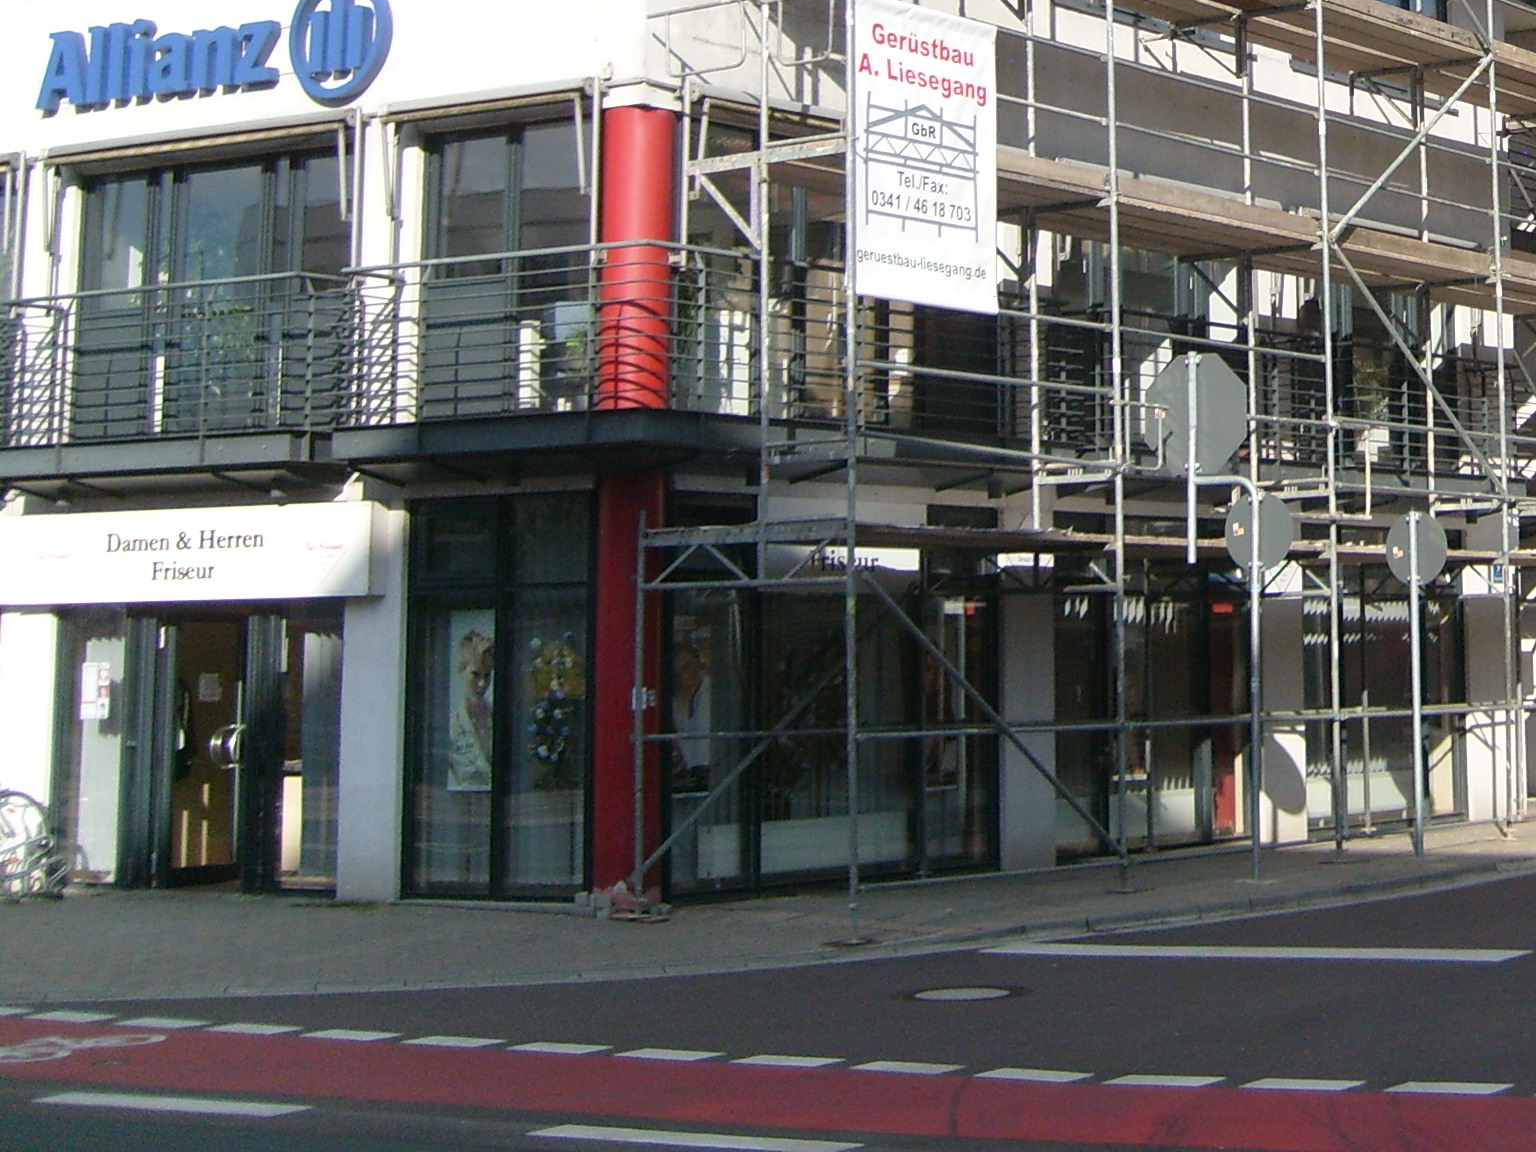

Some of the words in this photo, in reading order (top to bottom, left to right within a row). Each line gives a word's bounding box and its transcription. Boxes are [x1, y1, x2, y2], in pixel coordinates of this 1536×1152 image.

[871, 22, 975, 67] Gerüstbau
[35, 18, 282, 119] Allianz
[858, 52, 879, 77] A.
[886, 58, 988, 107] Liesegang
[911, 121, 937, 140] GbR
[871, 189, 901, 211] 0341
[913, 197, 929, 215] 46
[932, 201, 946, 218] 18
[949, 203, 972, 222] 703
[856, 249, 987, 281] geruestbau-liesegang.de
[106, 533, 170, 553] Damen
[175, 531, 193, 550] &
[198, 529, 264, 550] Herren
[151, 561, 215, 582] Friseur
[810, 543, 880, 572] Frisur
